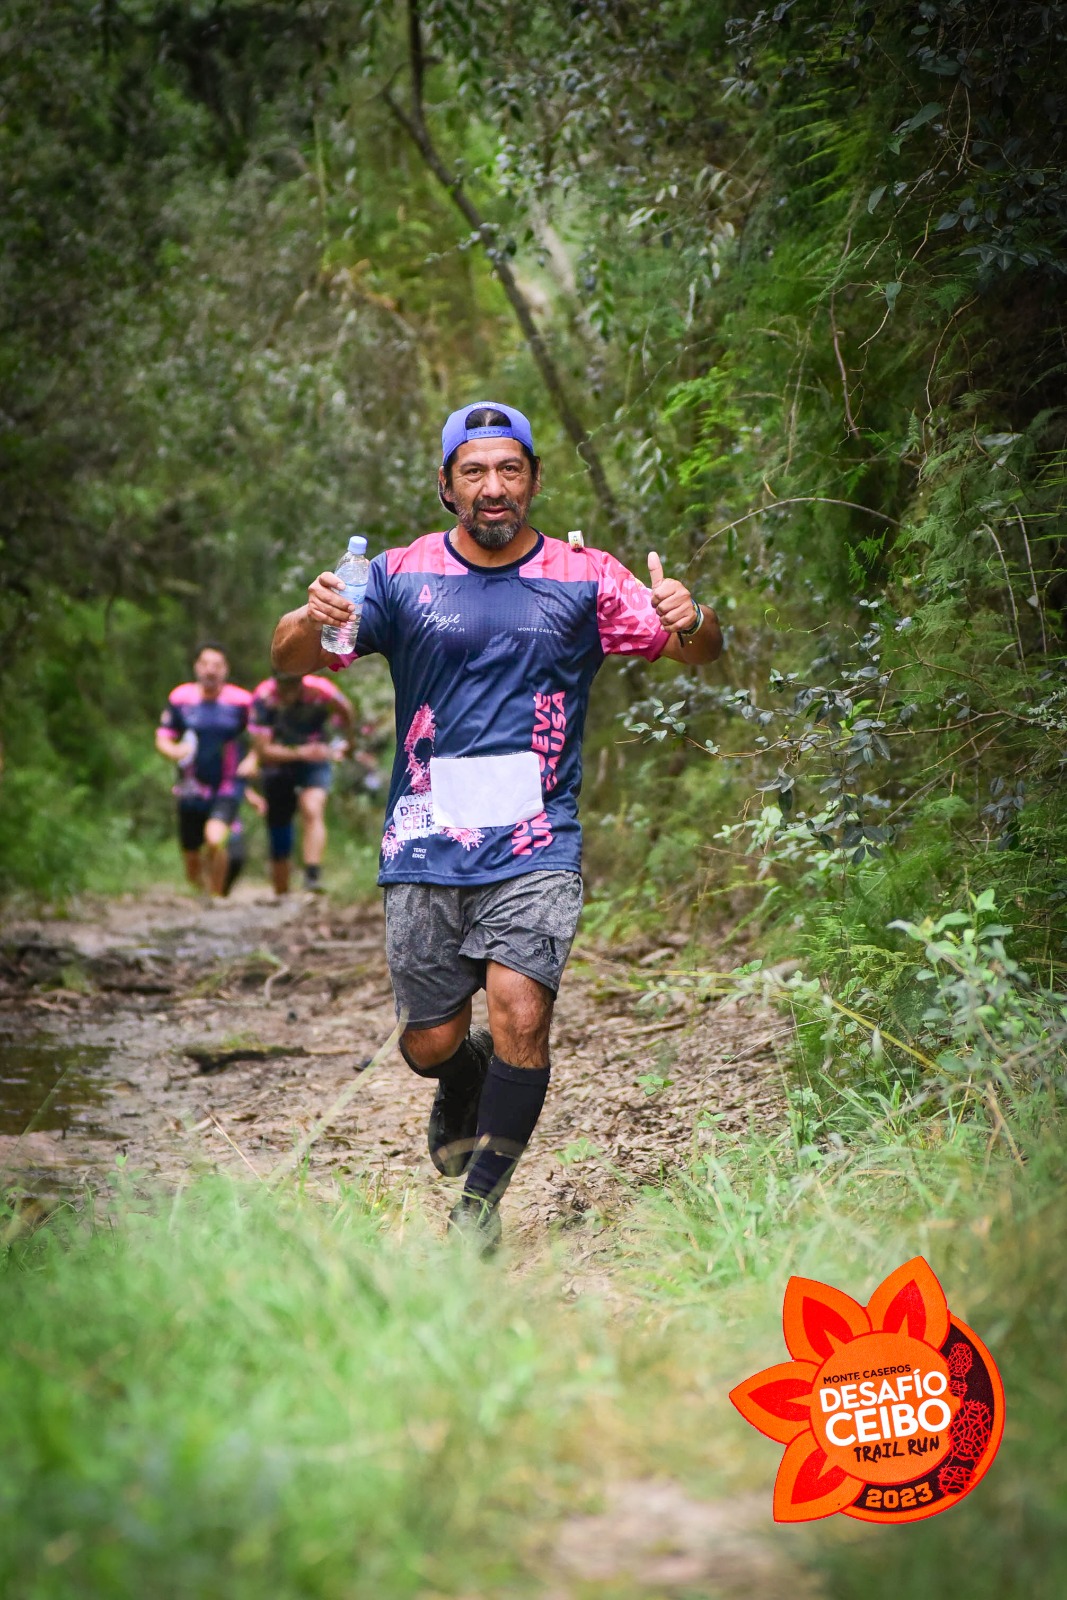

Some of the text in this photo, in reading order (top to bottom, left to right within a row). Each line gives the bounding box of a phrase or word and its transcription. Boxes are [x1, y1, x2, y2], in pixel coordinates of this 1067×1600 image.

[399, 801, 433, 816] DESAF
[402, 813, 435, 830] CEIB
[511, 819, 533, 856] NO
[530, 811, 554, 848] UN
